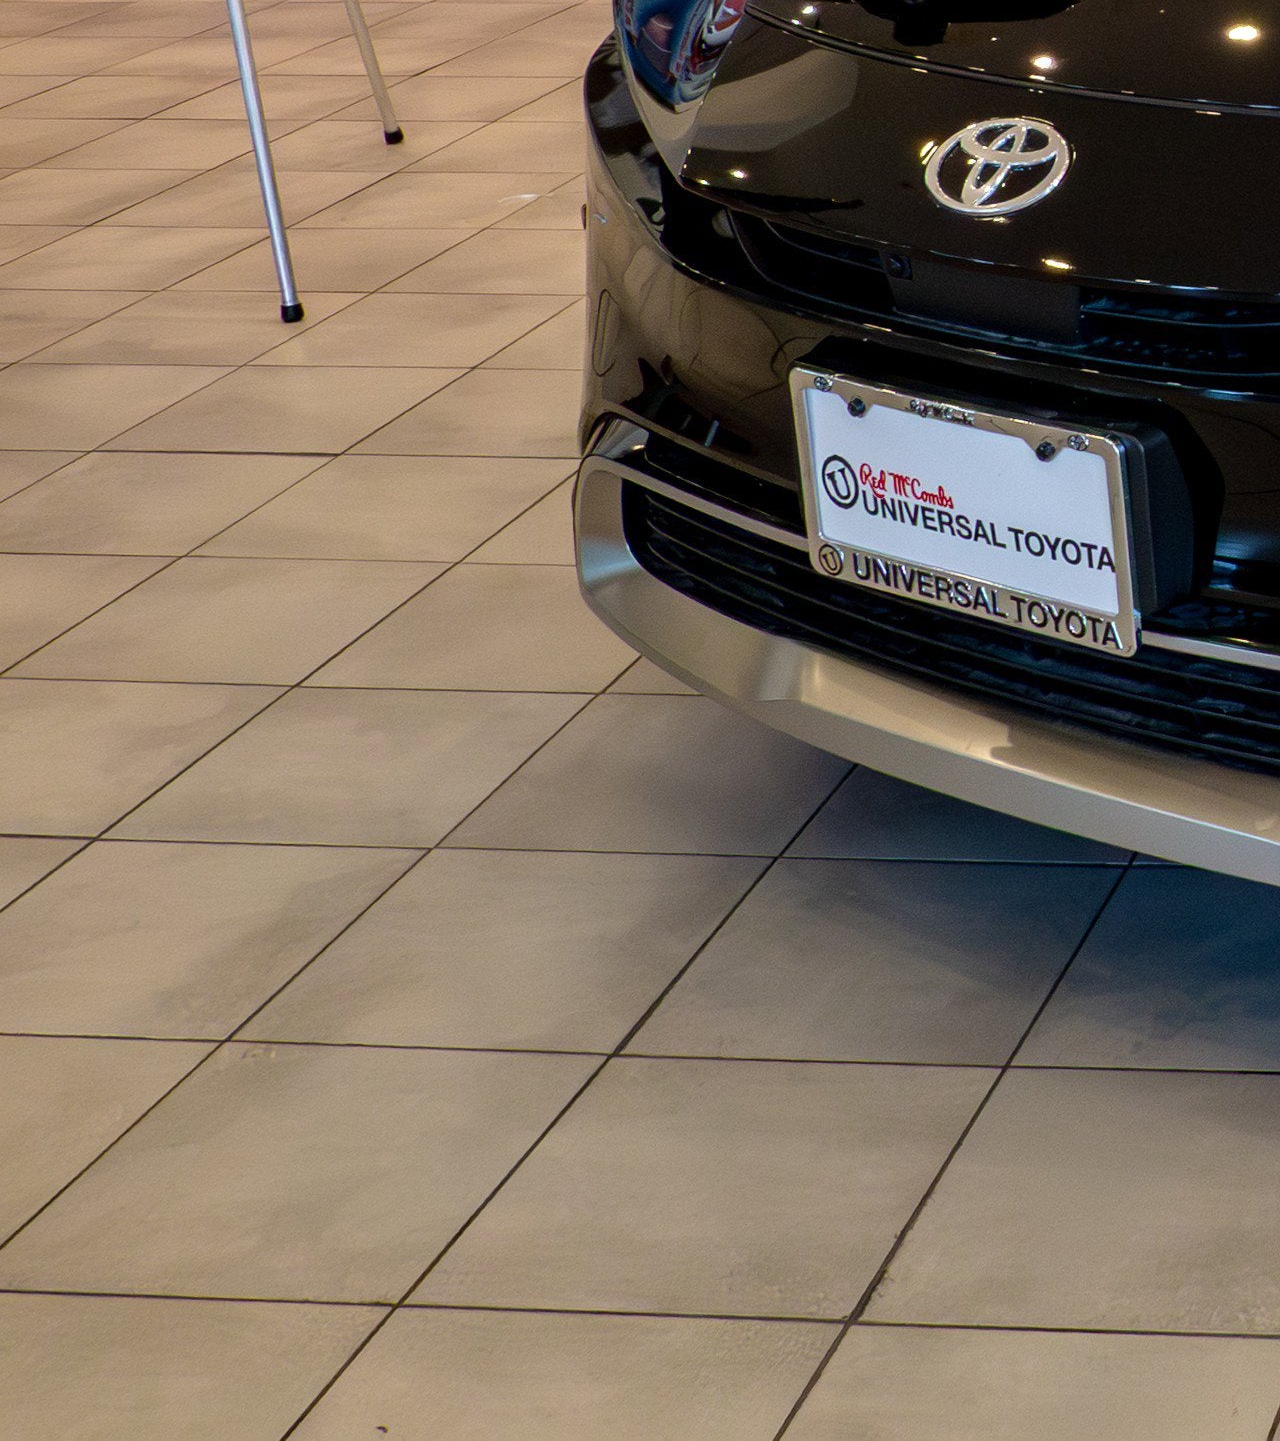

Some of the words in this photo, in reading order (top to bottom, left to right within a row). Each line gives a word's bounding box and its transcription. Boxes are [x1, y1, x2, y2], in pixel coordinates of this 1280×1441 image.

[858, 462, 887, 499] Red
[888, 471, 954, 509] McCombs
[861, 489, 1006, 550] UNIVERSAL
[1007, 526, 1117, 574] TOYOTA
[852, 552, 1009, 618] UNIVERSAL
[1010, 594, 1125, 650] TOYOTA
